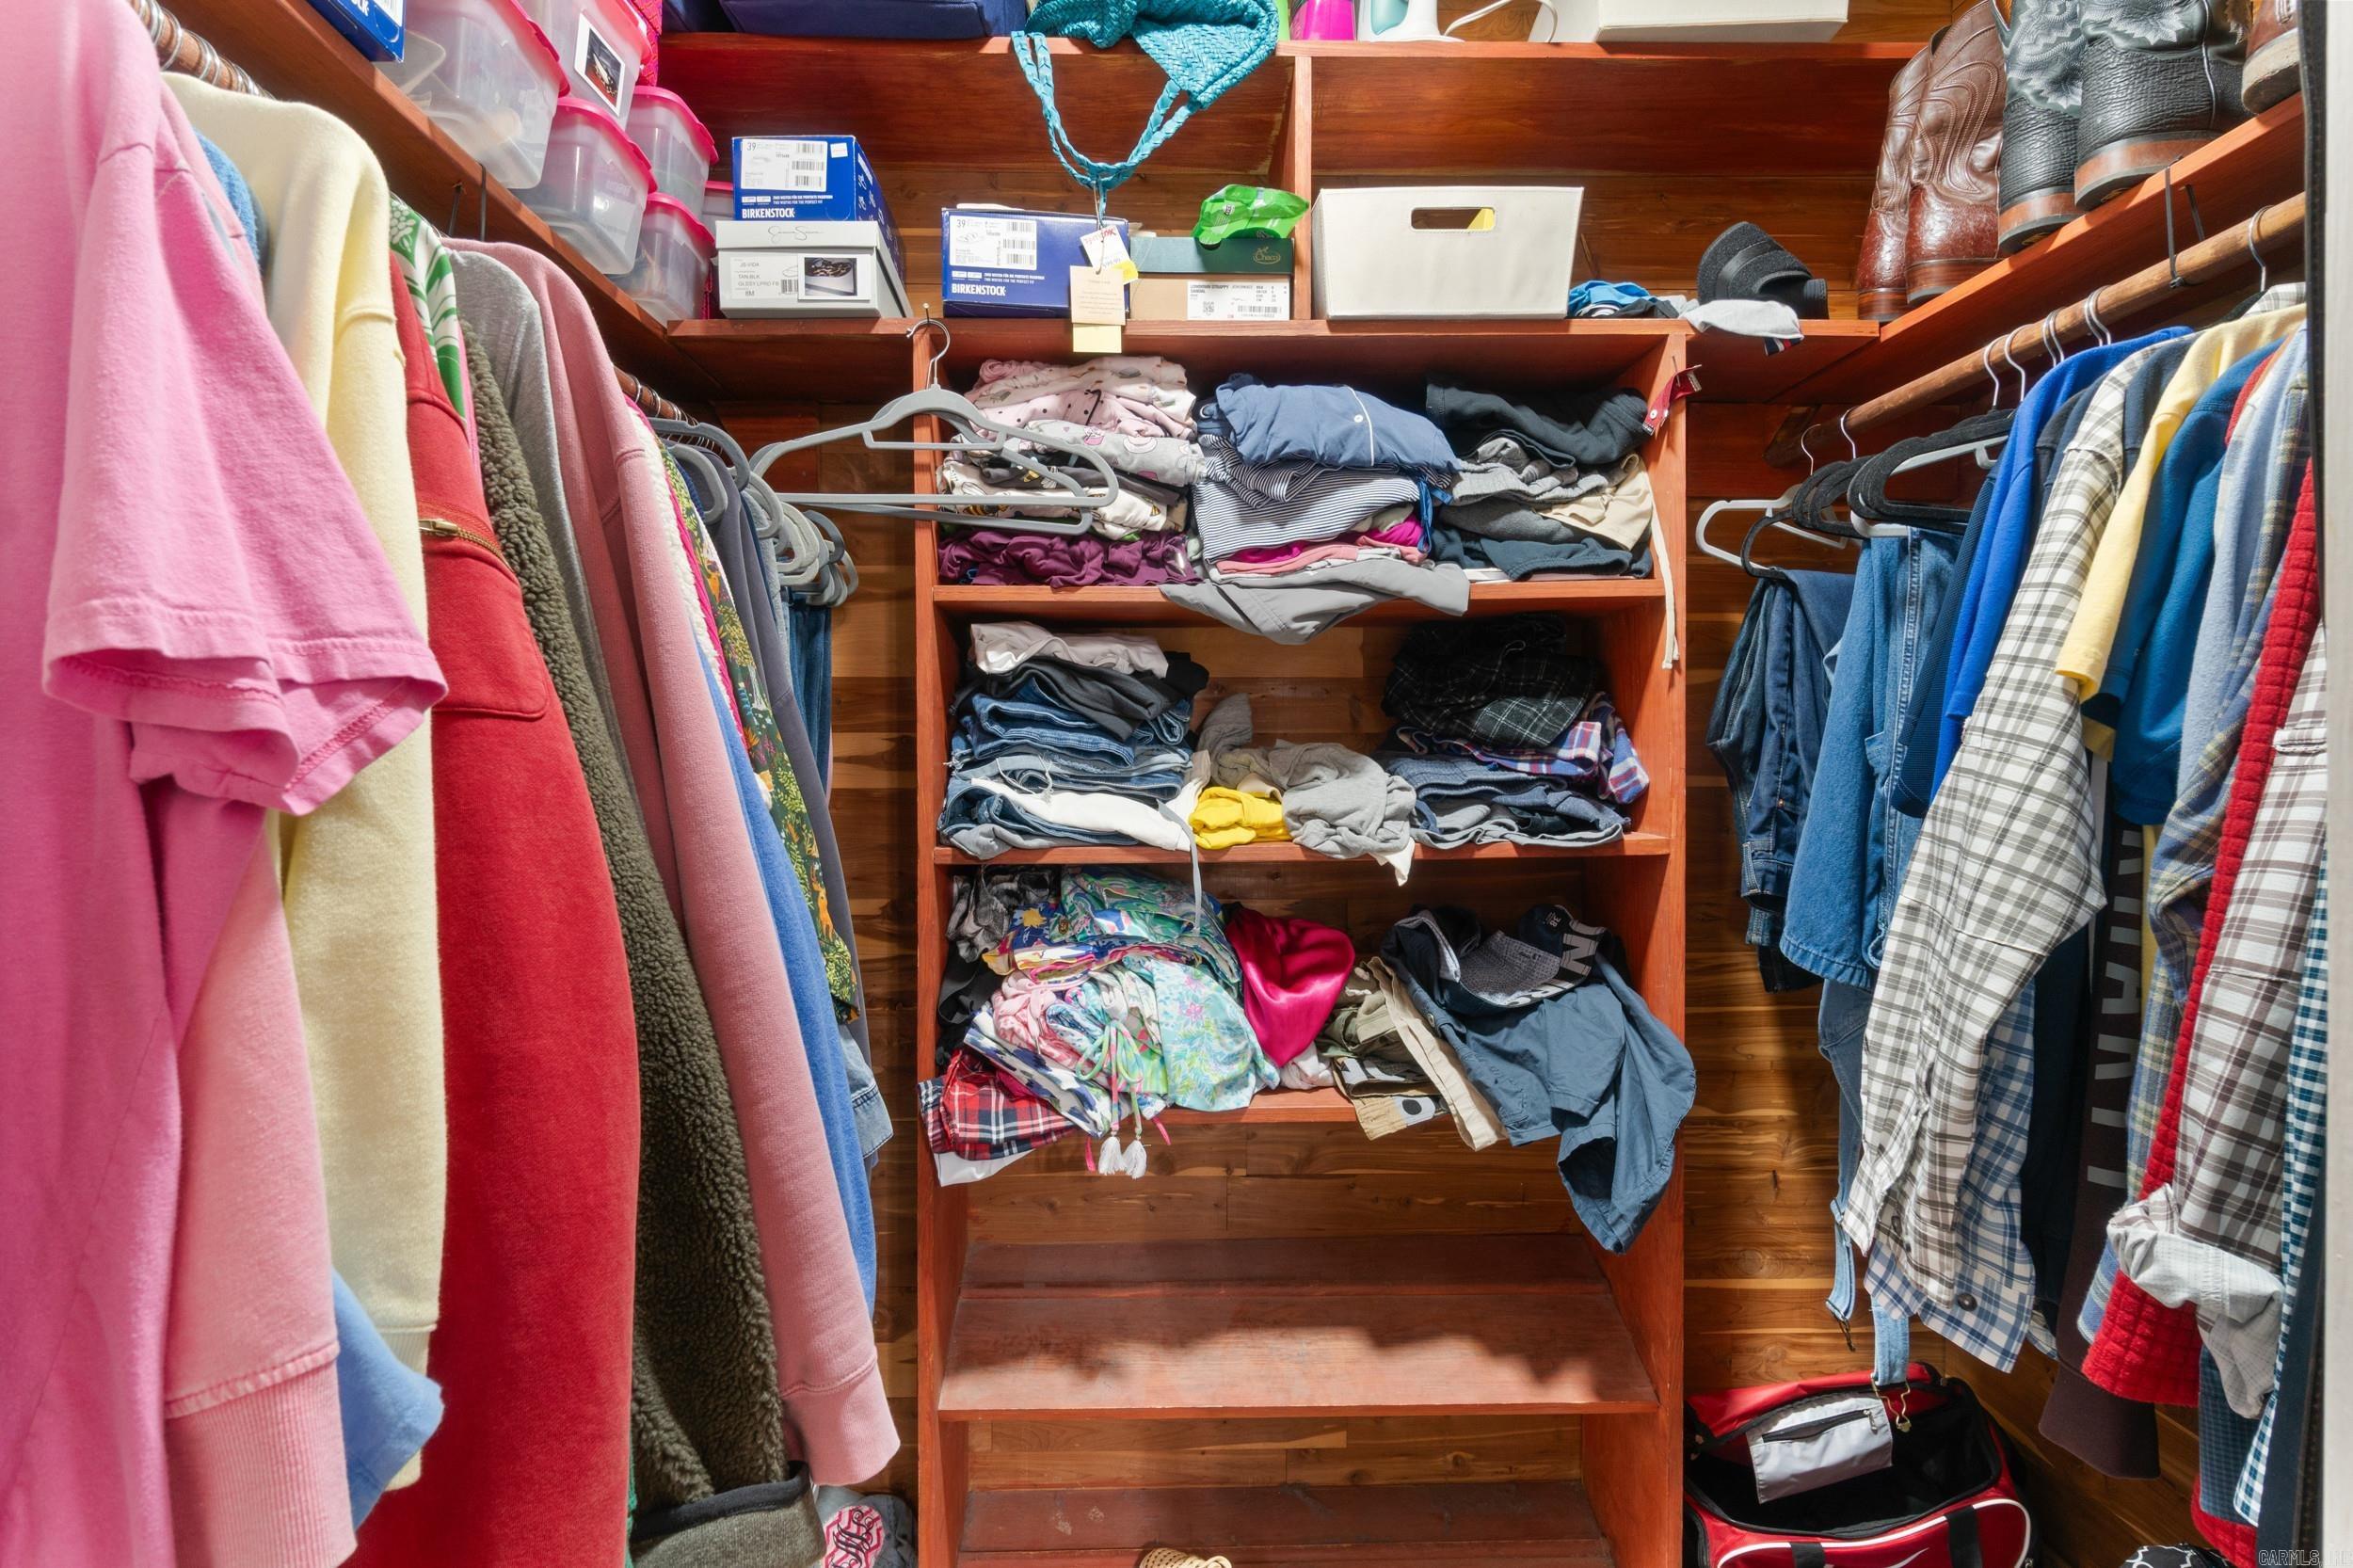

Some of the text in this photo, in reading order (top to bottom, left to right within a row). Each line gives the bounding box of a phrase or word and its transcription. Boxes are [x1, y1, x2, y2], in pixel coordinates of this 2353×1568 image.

[746, 142, 757, 151] 39
[742, 208, 795, 218] BIRKENSTOCK
[956, 219, 966, 228] 39
[952, 283, 1005, 296] BIRKENSTOCK
